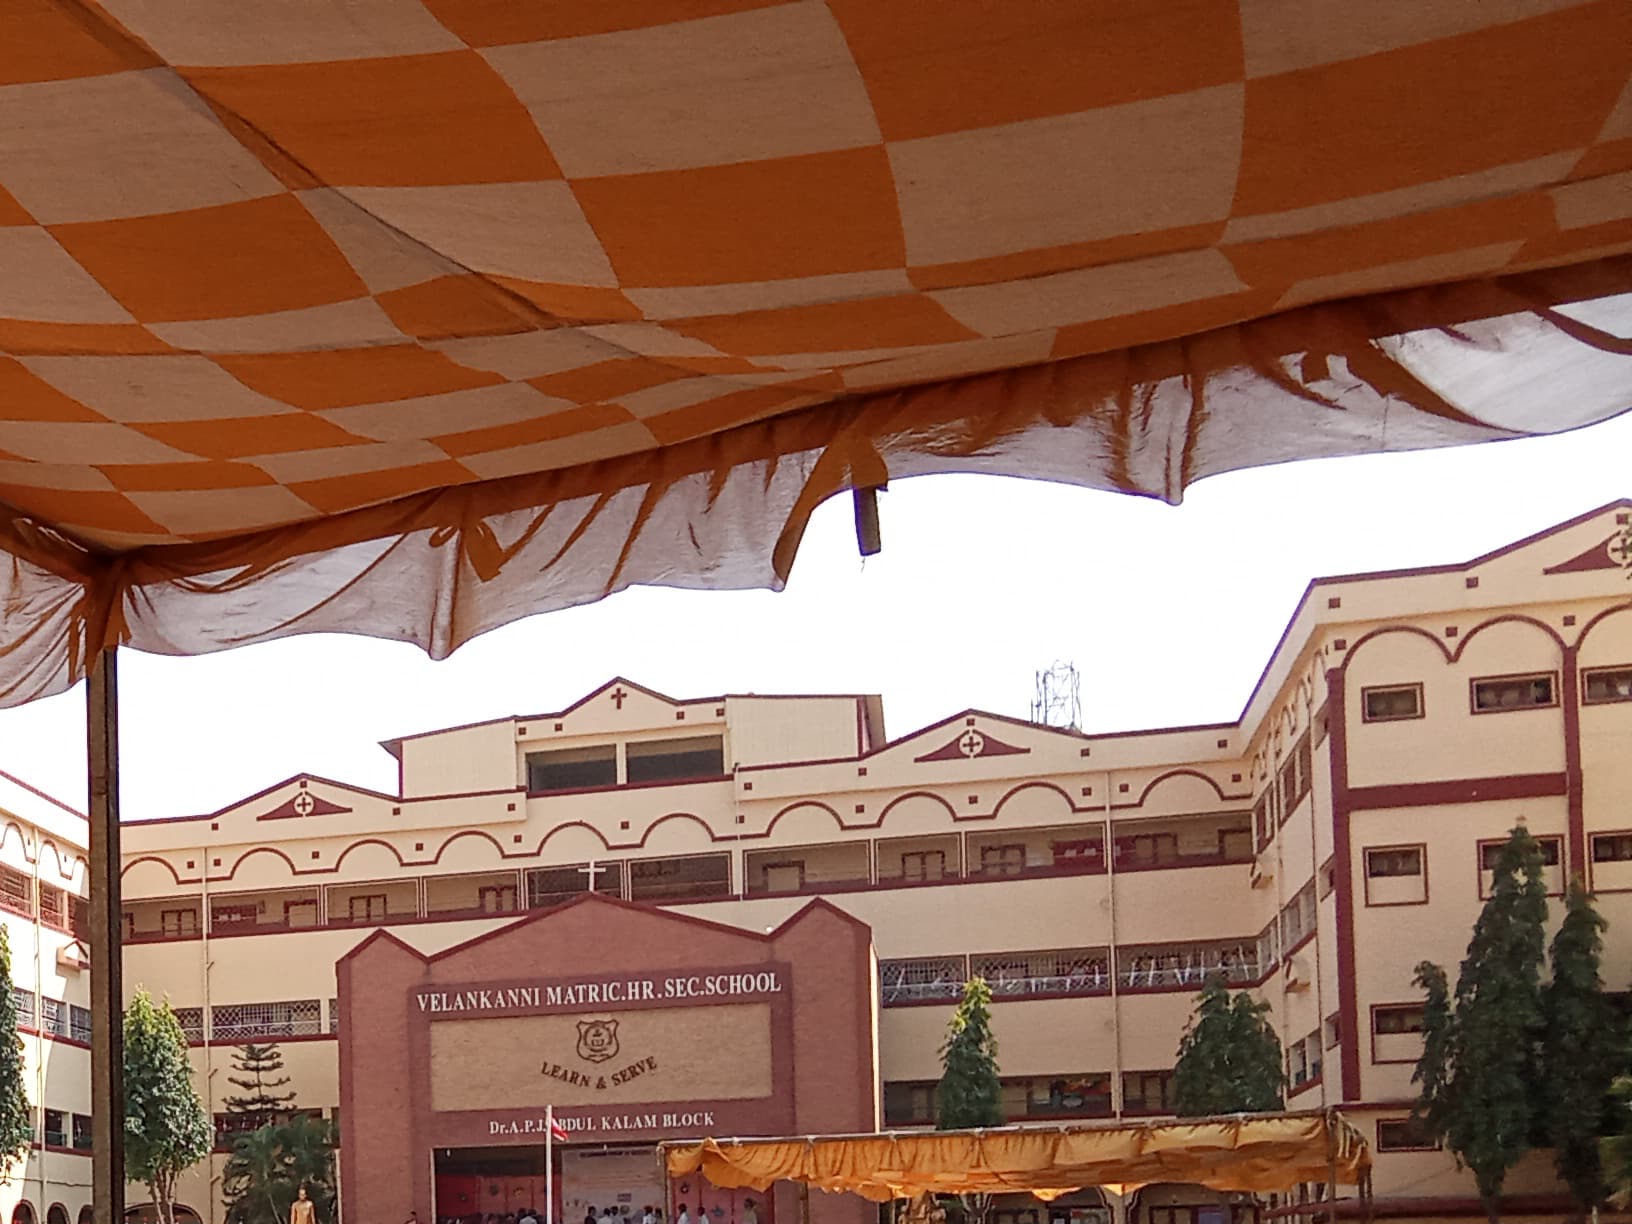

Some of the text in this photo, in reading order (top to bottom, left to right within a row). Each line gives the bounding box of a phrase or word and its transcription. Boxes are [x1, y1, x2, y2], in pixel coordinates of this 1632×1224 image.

[417, 988, 540, 1012] VELANKANNI
[541, 1055, 658, 1090] LEARN & SERVE
[601, 1114, 658, 1131] KALAM
[662, 1111, 715, 1128] BLOCK
